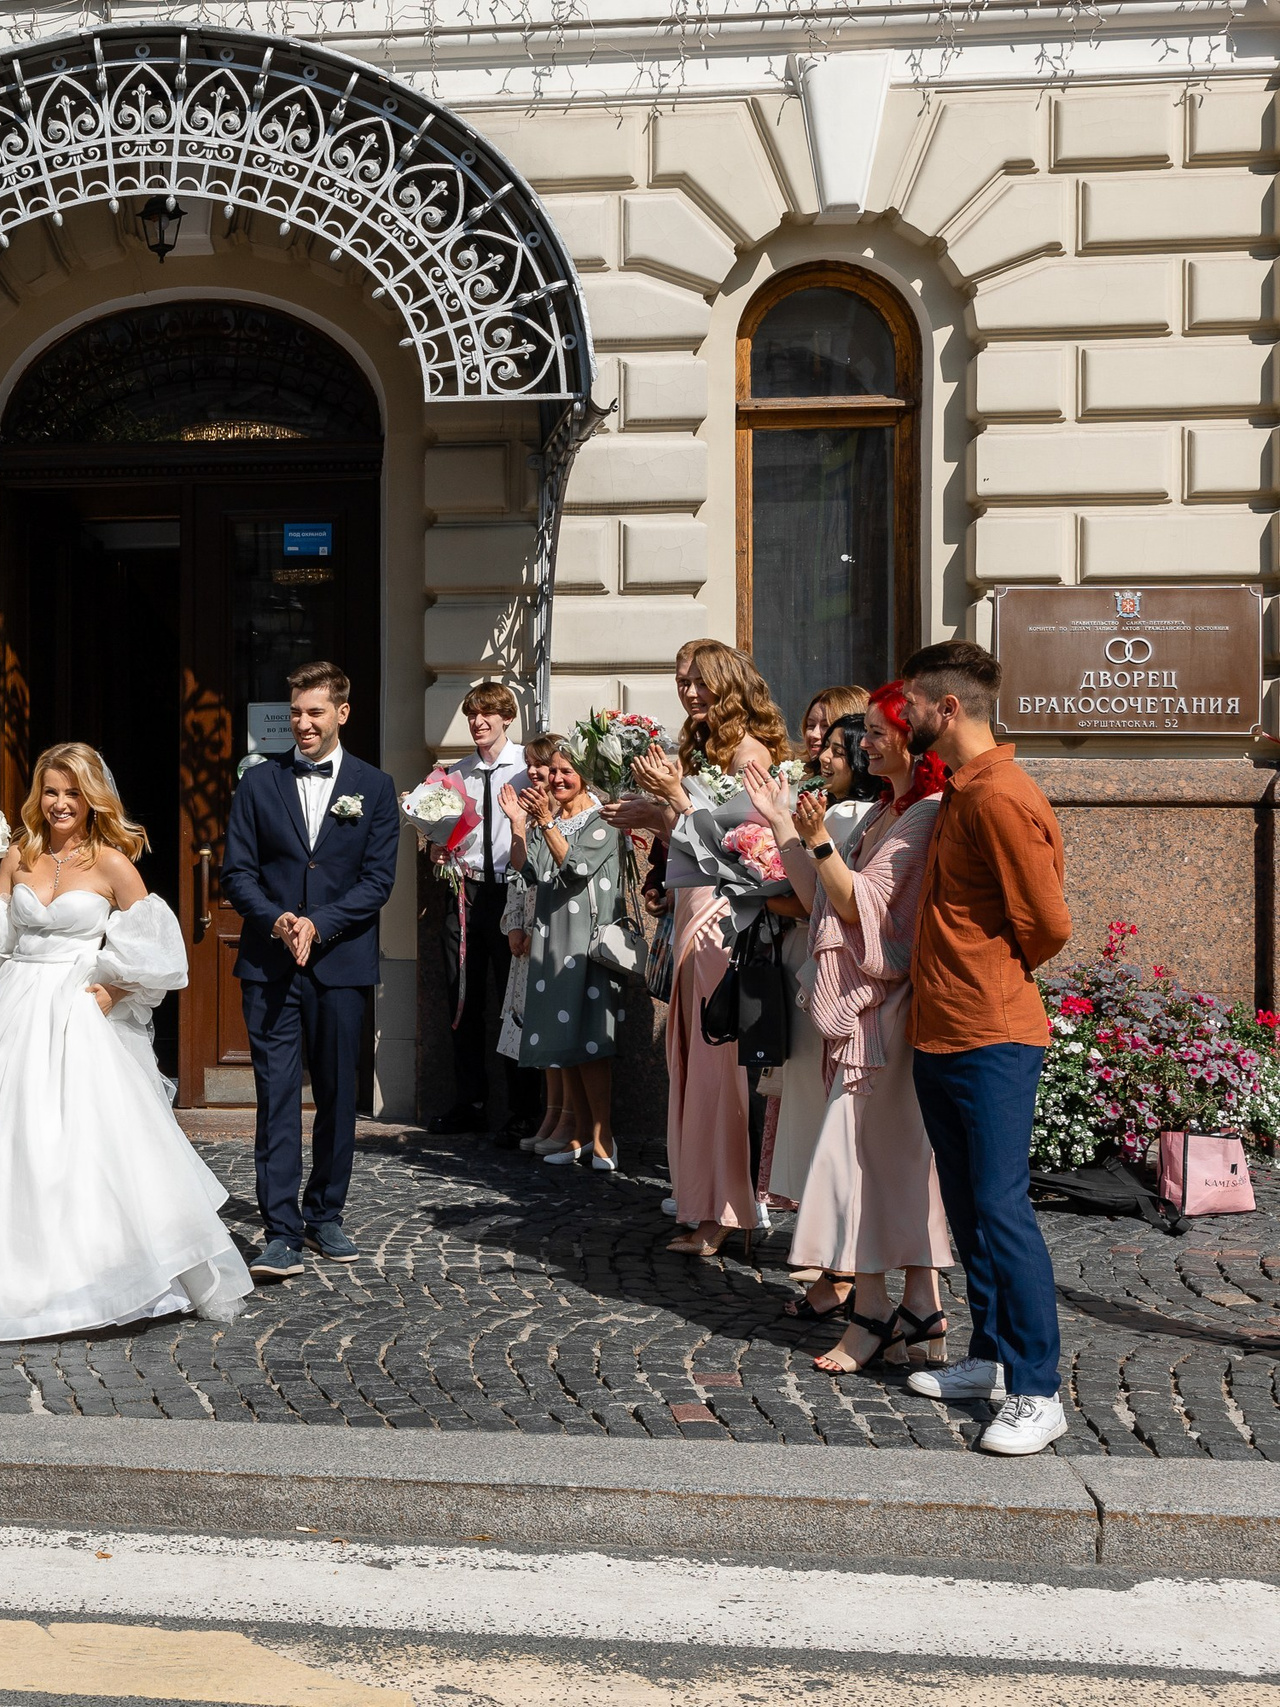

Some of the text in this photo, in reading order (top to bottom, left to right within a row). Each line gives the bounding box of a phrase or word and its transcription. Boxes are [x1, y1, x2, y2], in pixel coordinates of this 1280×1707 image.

[1079, 671, 1178, 690] ДВОРЕЦ
[1018, 697, 1240, 714] БРАКОСОЧЕТАНИЯ
[1164, 719, 1179, 728] 52
